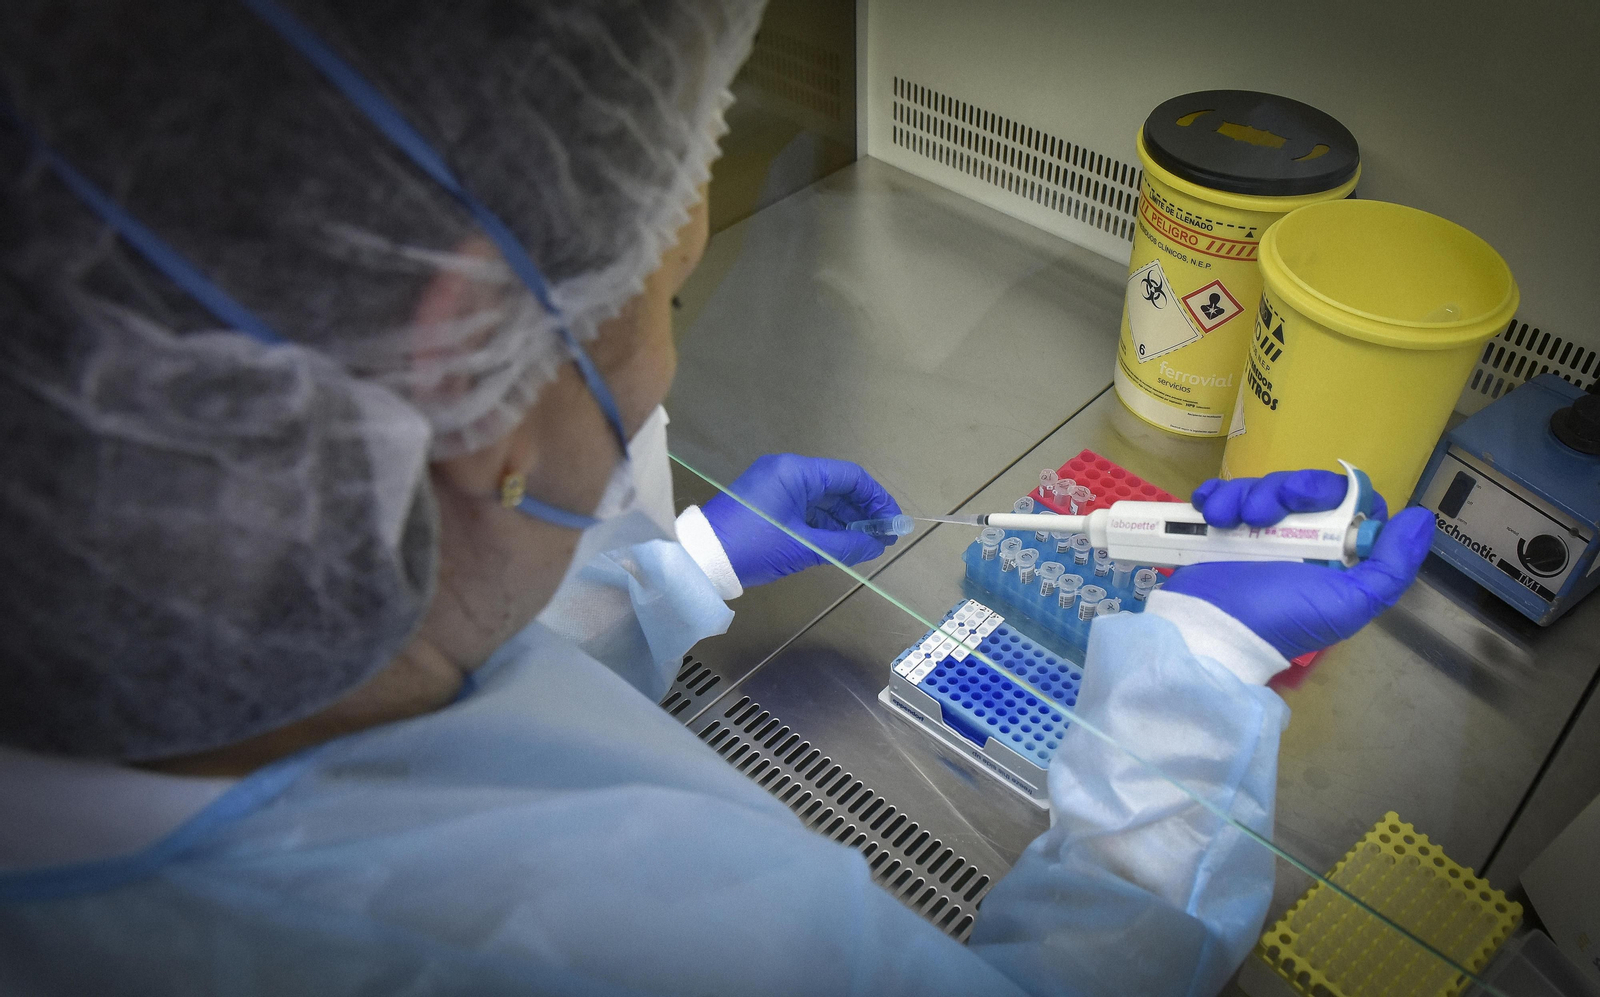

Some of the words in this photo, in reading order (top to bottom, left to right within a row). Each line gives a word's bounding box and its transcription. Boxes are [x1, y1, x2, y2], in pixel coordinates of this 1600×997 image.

[1151, 212, 1199, 246] PELIGRO
[1165, 206, 1175, 216] DE
[1175, 211, 1214, 232] LLENADO
[1190, 258, 1212, 270] N.E.P.
[1139, 343, 1146, 356] 6
[1157, 377, 1191, 394] servicios
[1160, 361, 1233, 388] ferrovial
[1434, 512, 1497, 563] techmatic
[1011, 776, 1033, 795] freeze
